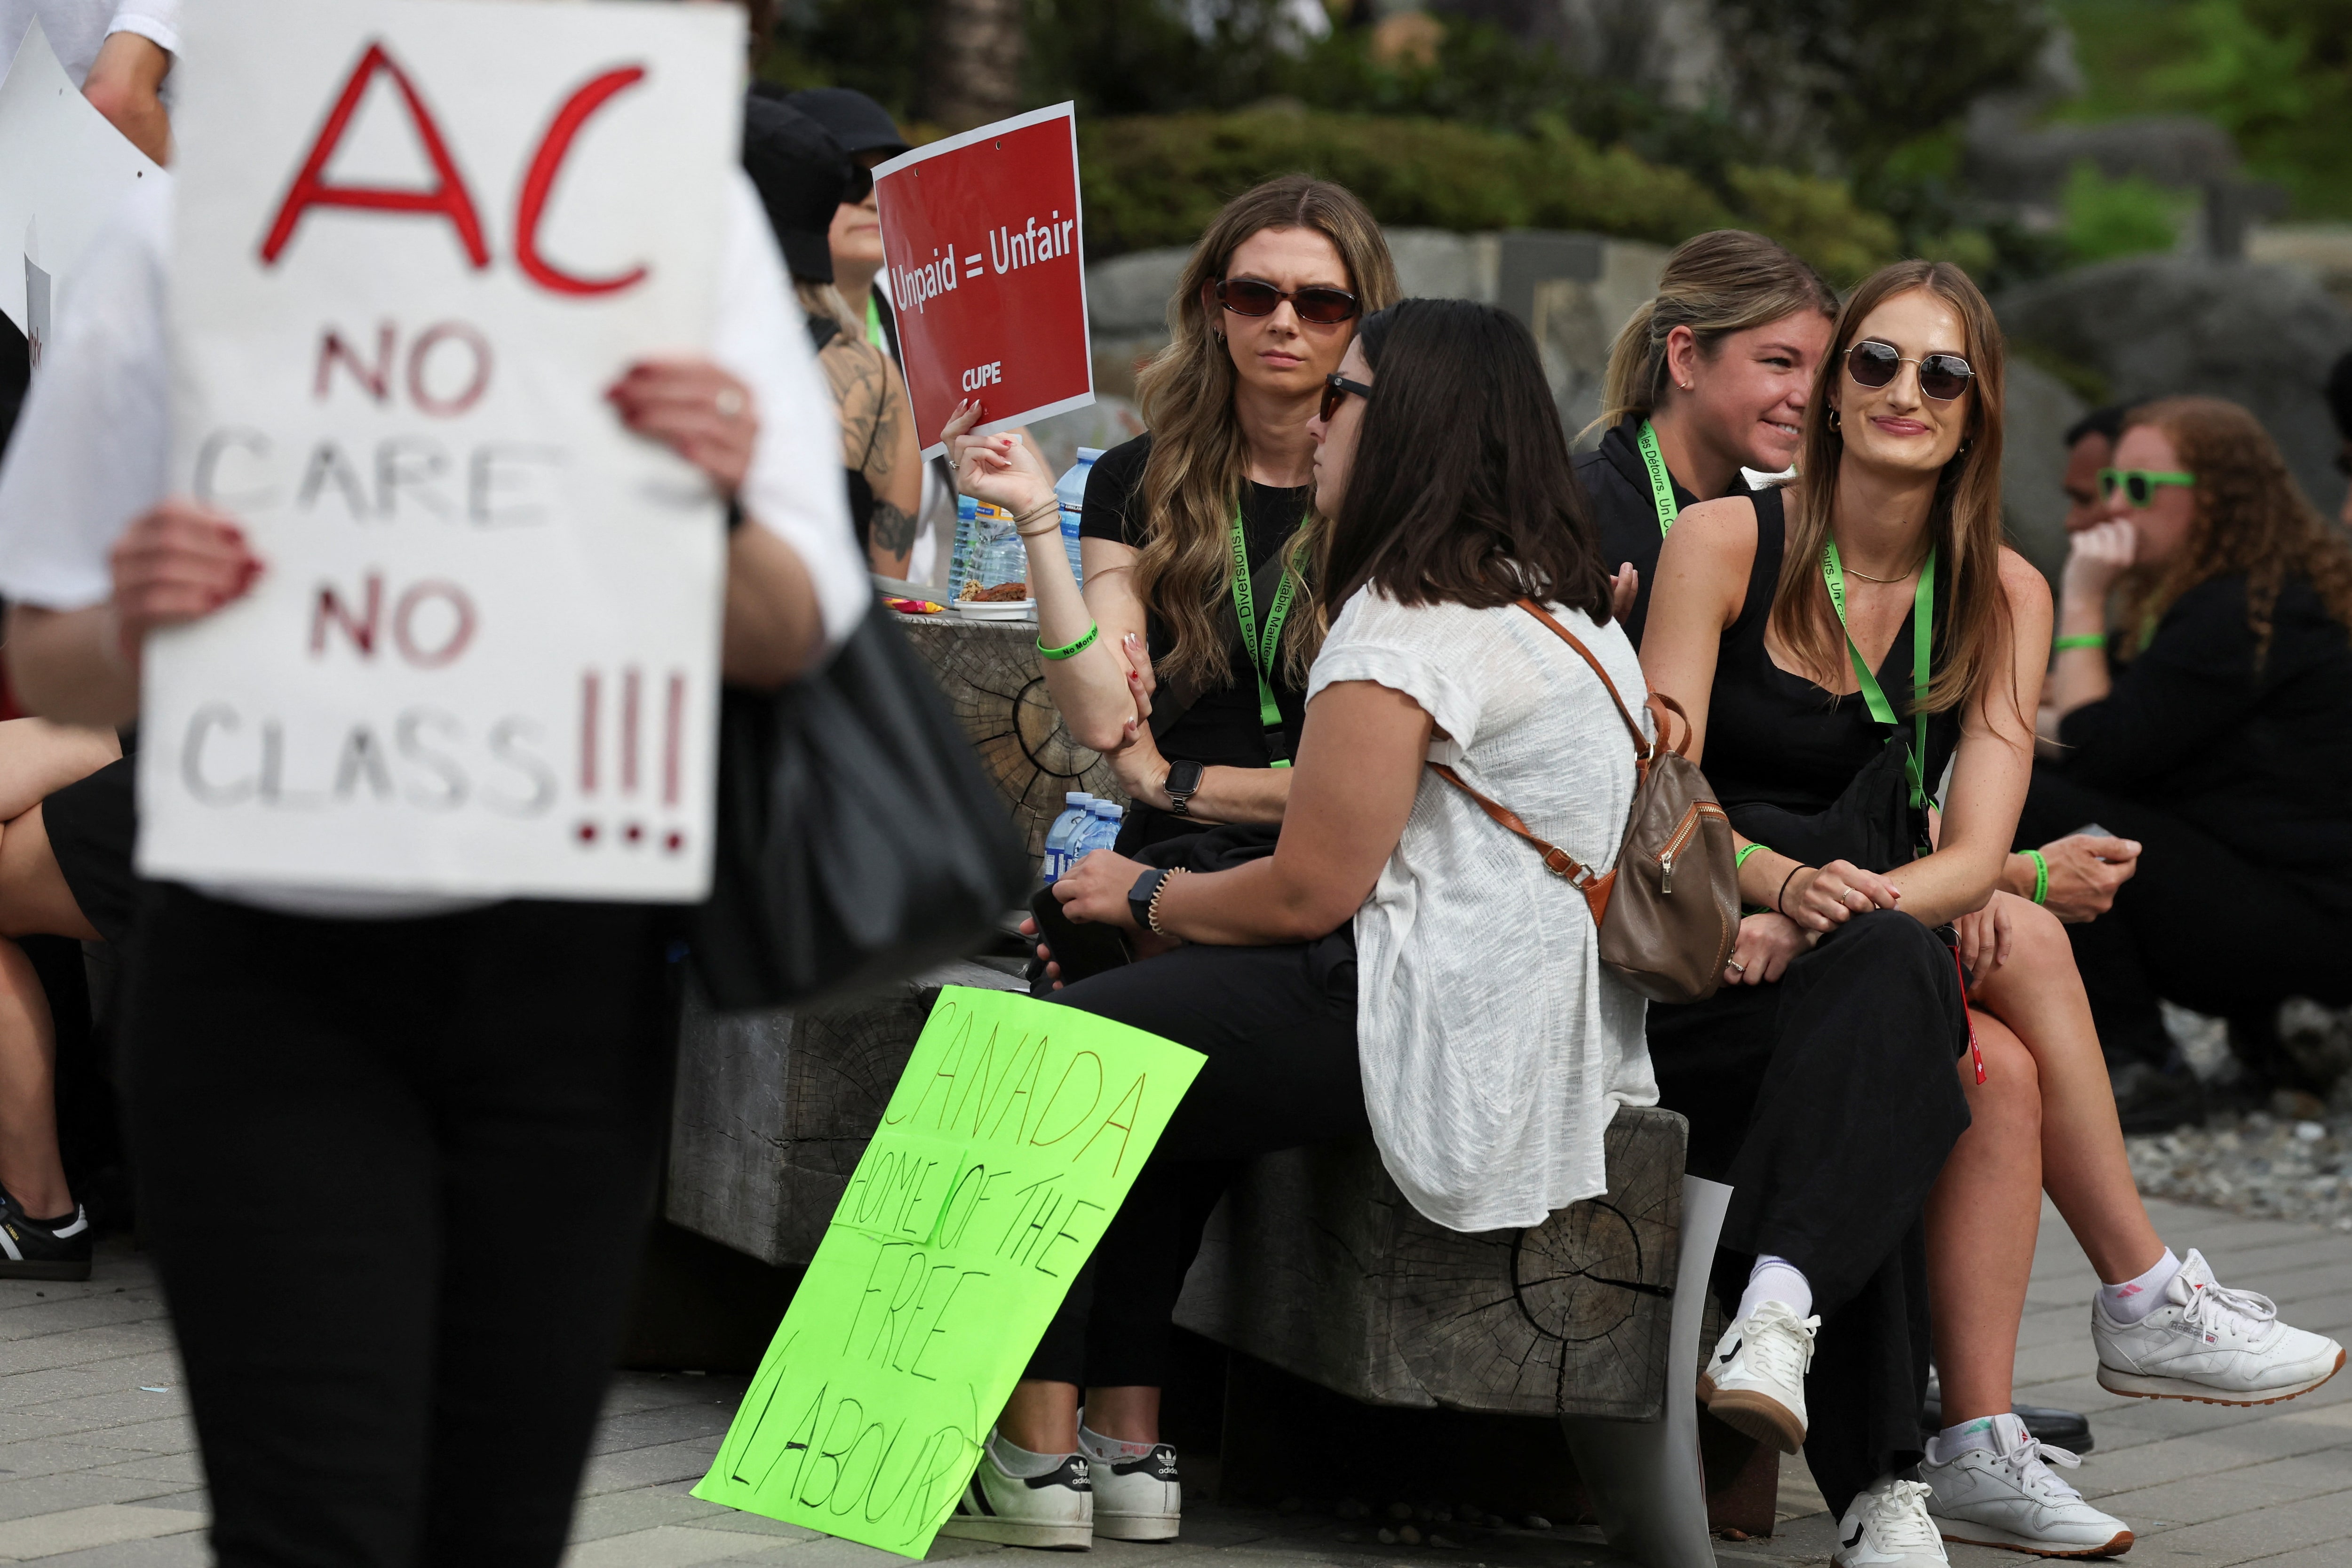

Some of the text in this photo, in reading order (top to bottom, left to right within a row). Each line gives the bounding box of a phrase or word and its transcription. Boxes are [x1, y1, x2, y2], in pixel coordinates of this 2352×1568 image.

[254, 38, 650, 299] AC
[892, 243, 957, 314] Unpaid
[990, 210, 1073, 275] Unfair
[313, 320, 494, 419] NO
[962, 361, 1001, 392] CUPE
[193, 426, 576, 529] CARE
[1641, 436, 1651, 449] les
[1645, 451, 1664, 495] Détours.
[1659, 498, 1671, 515] Un
[308, 569, 480, 670] NO
[1831, 582, 1842, 599] Un
[1075, 635, 1093, 650] More
[885, 1002, 1146, 1178] CANADA
[839, 1141, 1105, 1278] HOME OF THE
[842, 1242, 991, 1381] FREE
